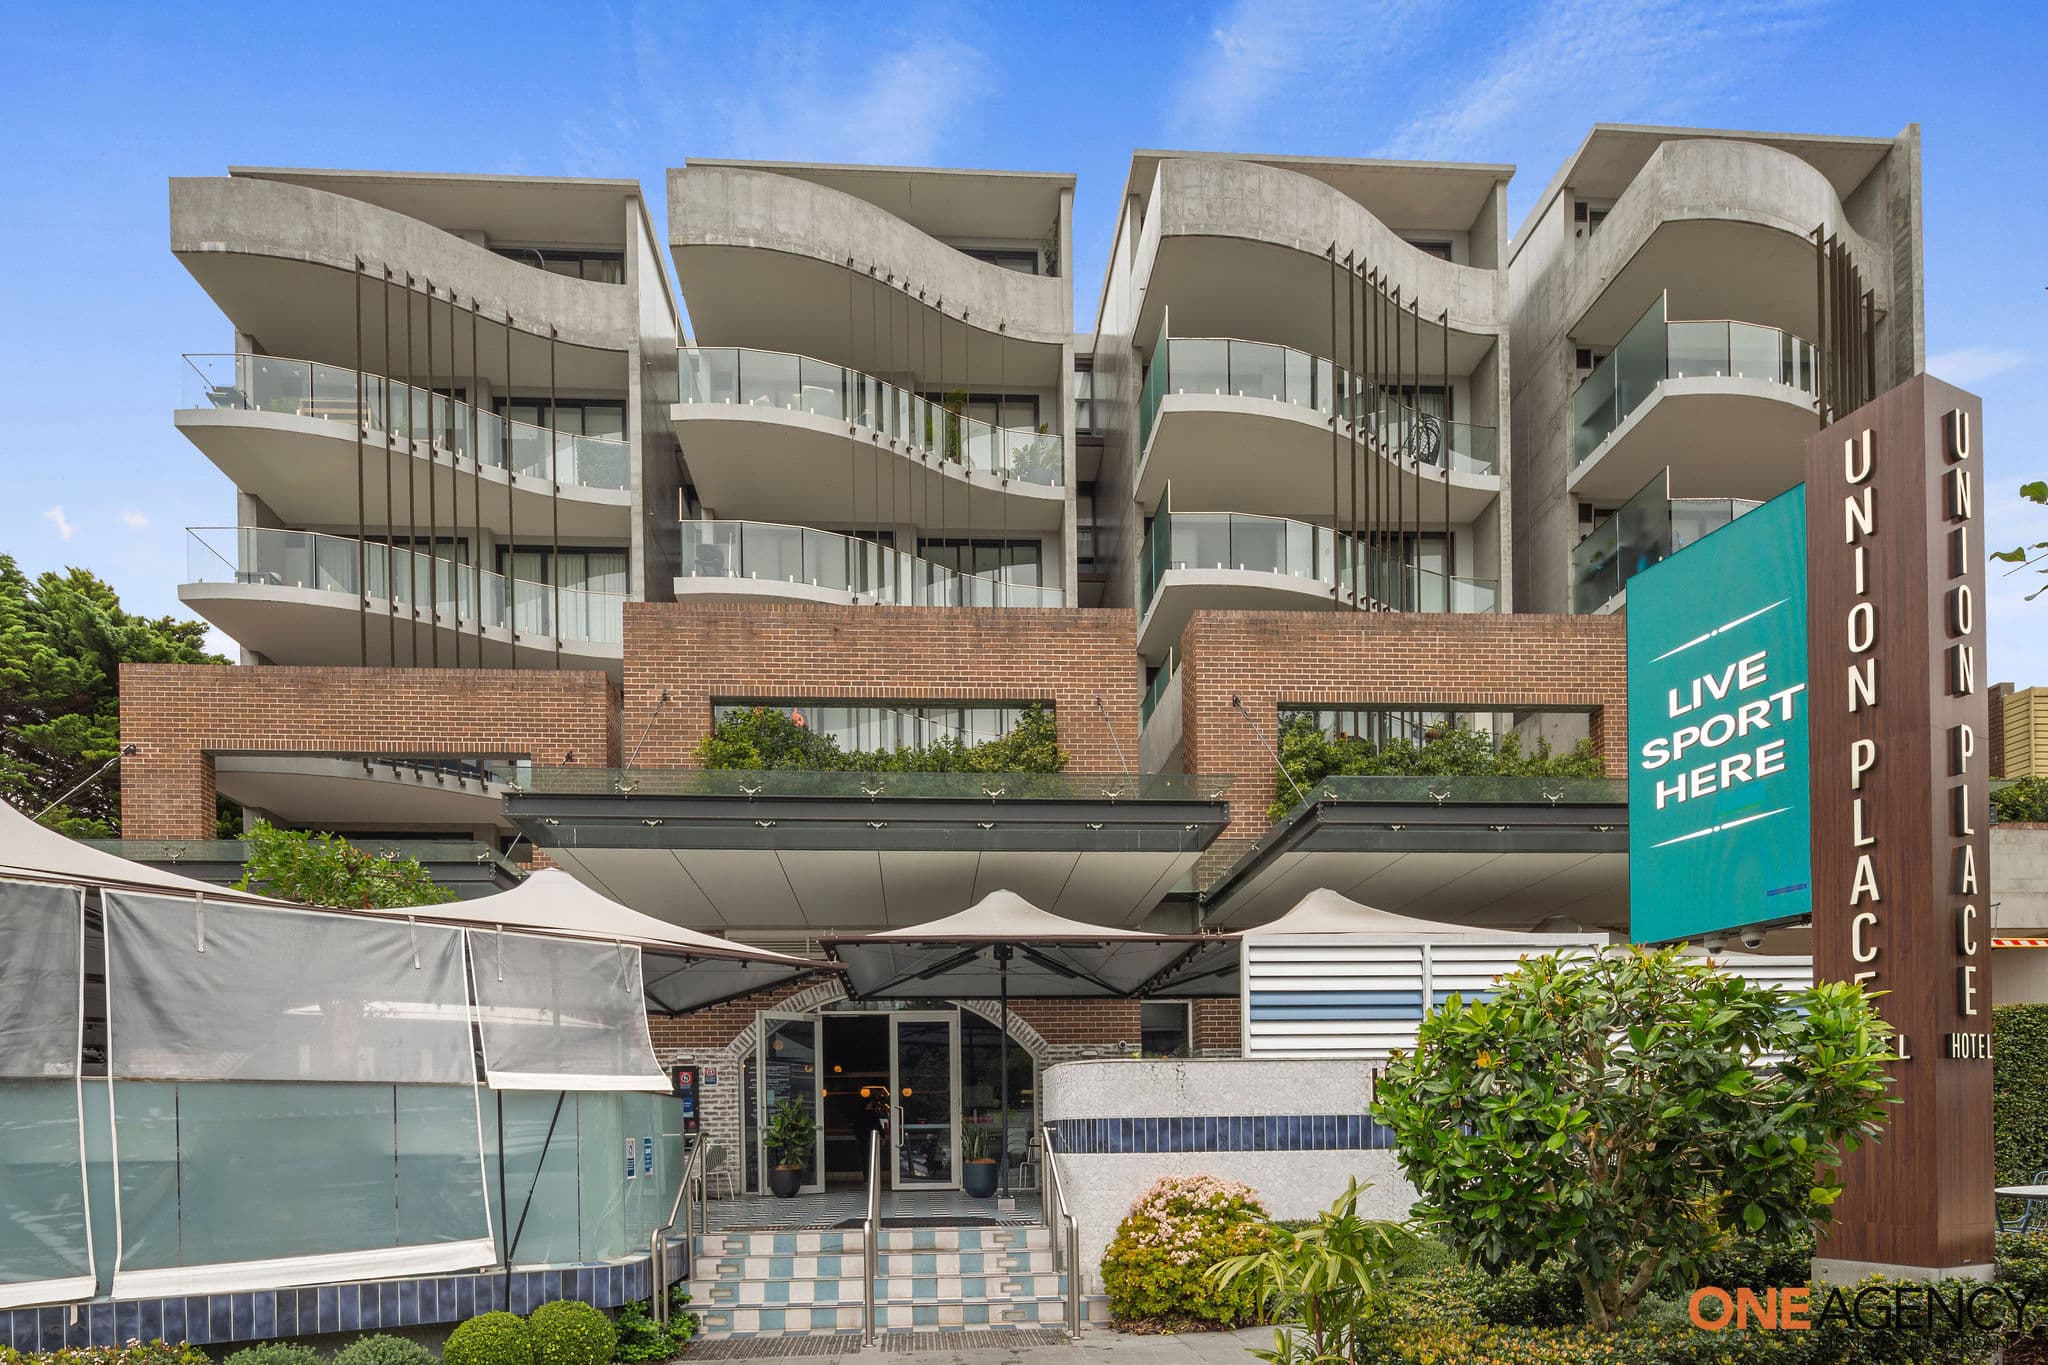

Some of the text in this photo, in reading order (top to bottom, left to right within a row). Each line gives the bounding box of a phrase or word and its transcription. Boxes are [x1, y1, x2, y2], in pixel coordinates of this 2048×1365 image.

[1844, 428, 1876, 714] UNION
[1668, 650, 1768, 718] LIVE
[1952, 407, 1979, 1016] UNION PLACE
[1641, 683, 1806, 770] SPORT
[1656, 739, 1786, 810] HERE
[1952, 1032, 1993, 1059] HOTEL
